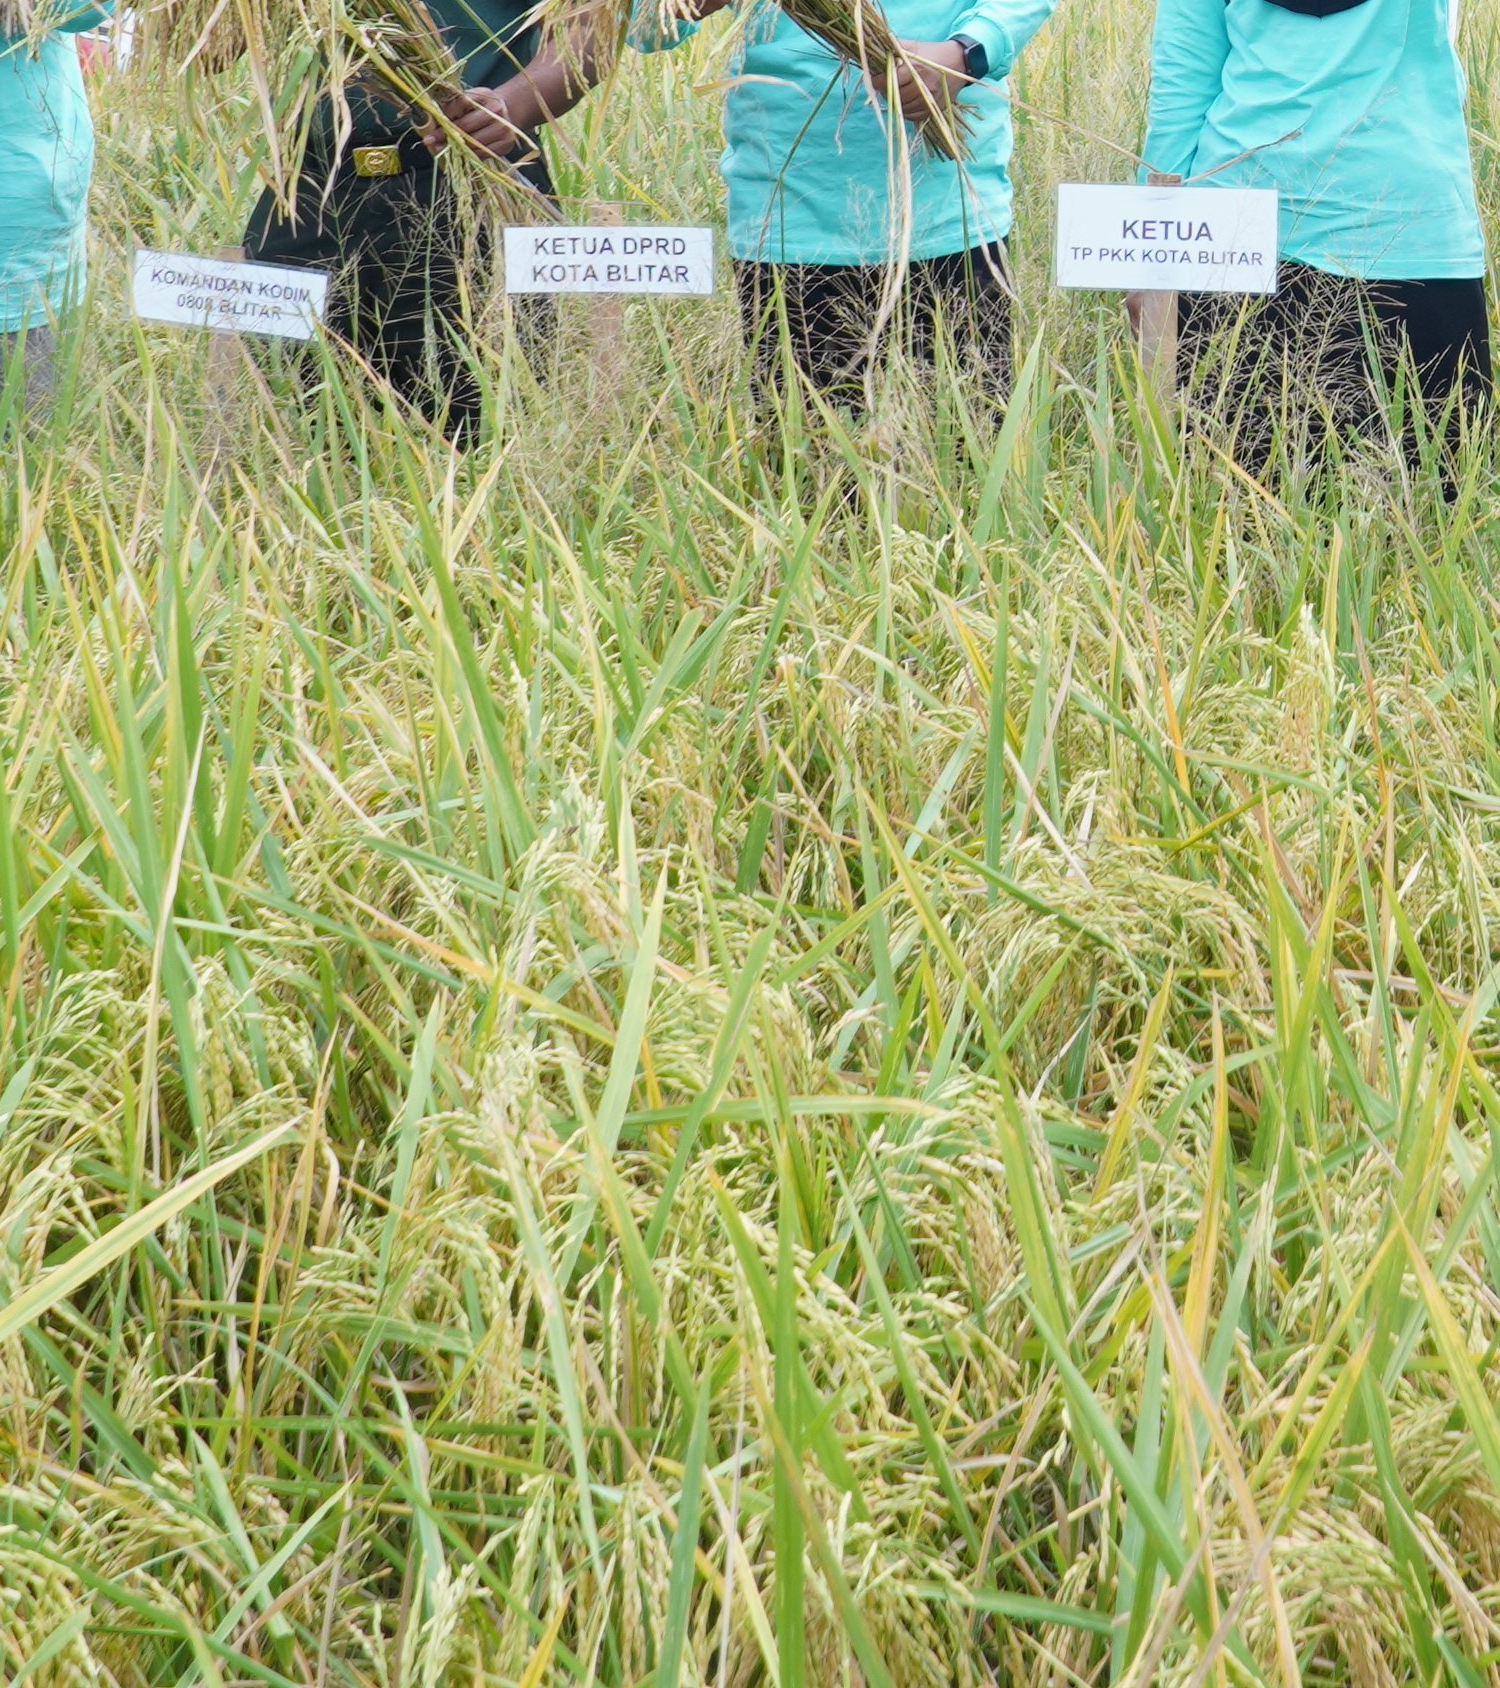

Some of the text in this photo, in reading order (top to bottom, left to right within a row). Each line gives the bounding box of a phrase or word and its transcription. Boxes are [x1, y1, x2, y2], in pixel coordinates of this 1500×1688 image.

[1122, 219, 1214, 242] KETUA
[534, 237, 686, 255] KETUA DPRD
[1071, 246, 1263, 266] TP PKK KOTA BLITAR
[533, 265, 690, 283] KOTA BLITAR
[152, 268, 311, 302] KOMANDAN KODIM
